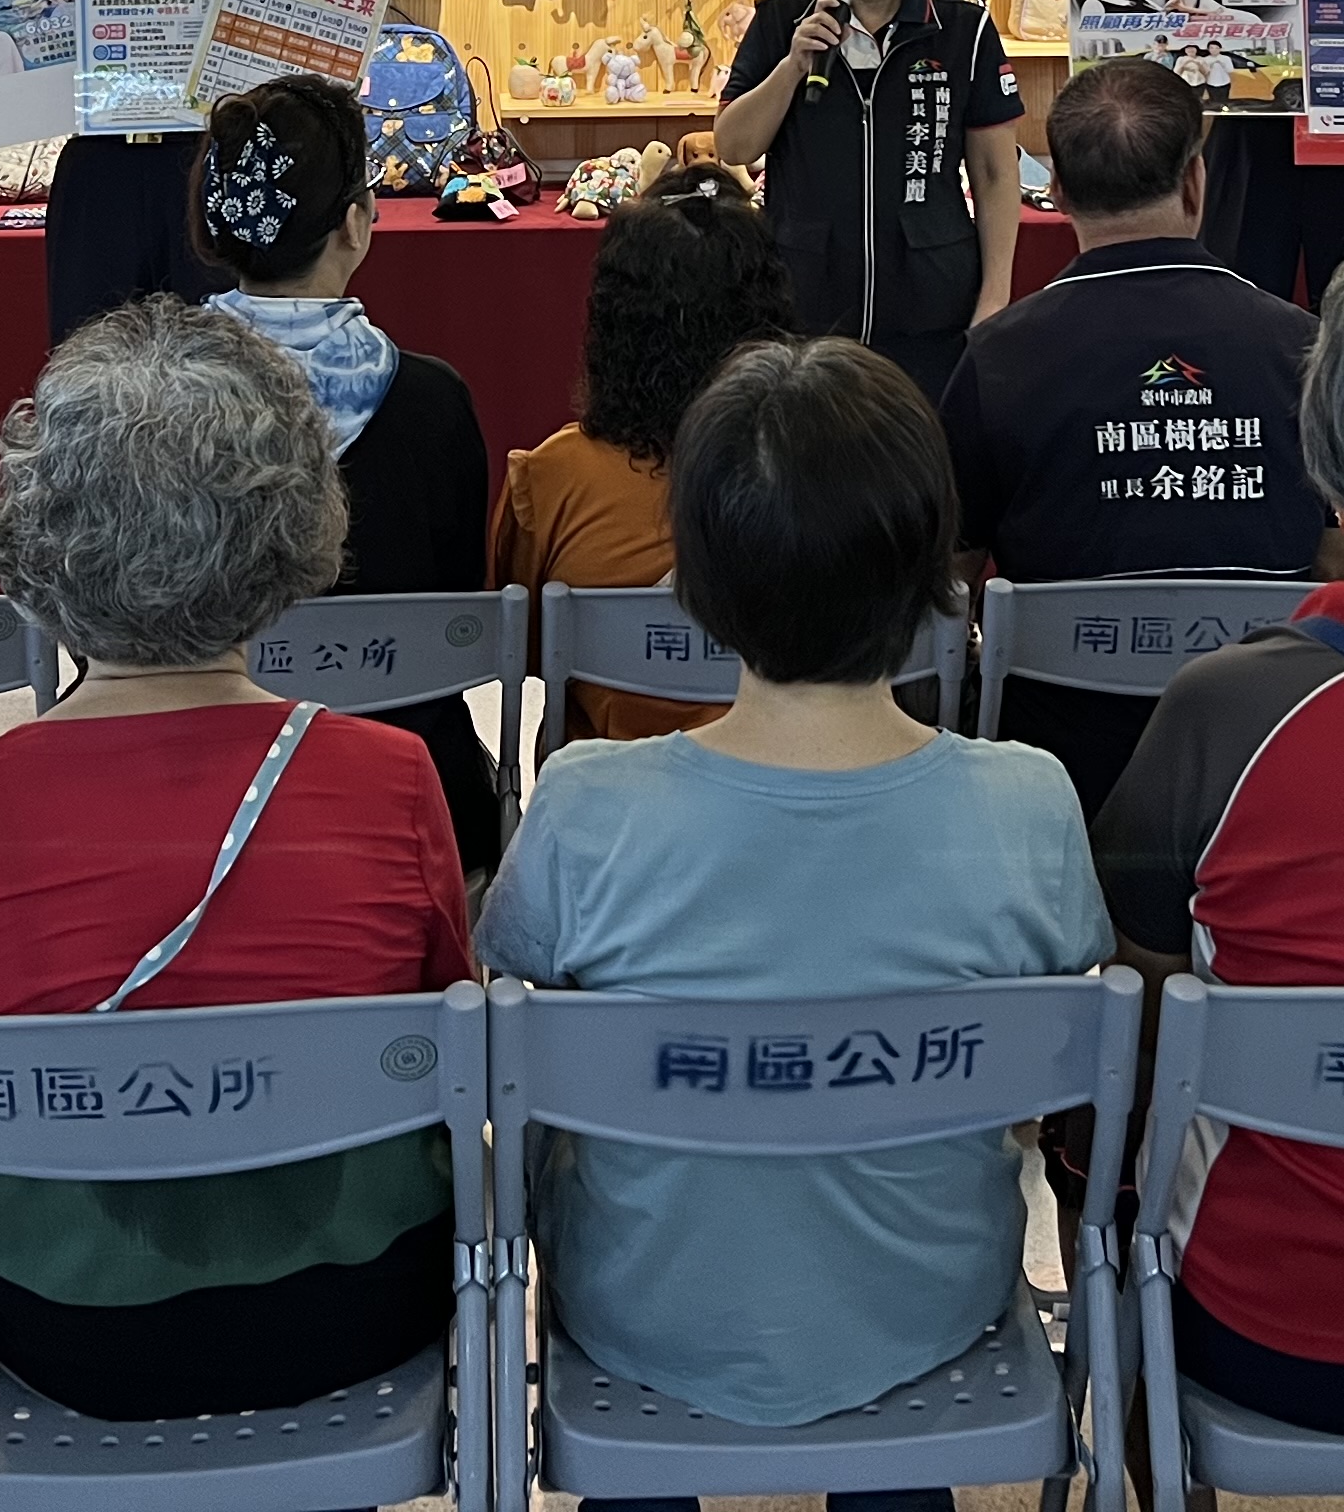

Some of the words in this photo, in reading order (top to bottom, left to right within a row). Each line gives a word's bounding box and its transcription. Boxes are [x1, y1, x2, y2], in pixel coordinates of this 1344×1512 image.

[26, 15, 72, 34] 6,032
[1080, 14, 1188, 30] 照顧再升級
[1140, 388, 1213, 407] 臺中市政府
[1094, 417, 1263, 454] 南區樹德里
[256, 639, 397, 675] 區公所
[656, 1022, 984, 1092] 南區公所
